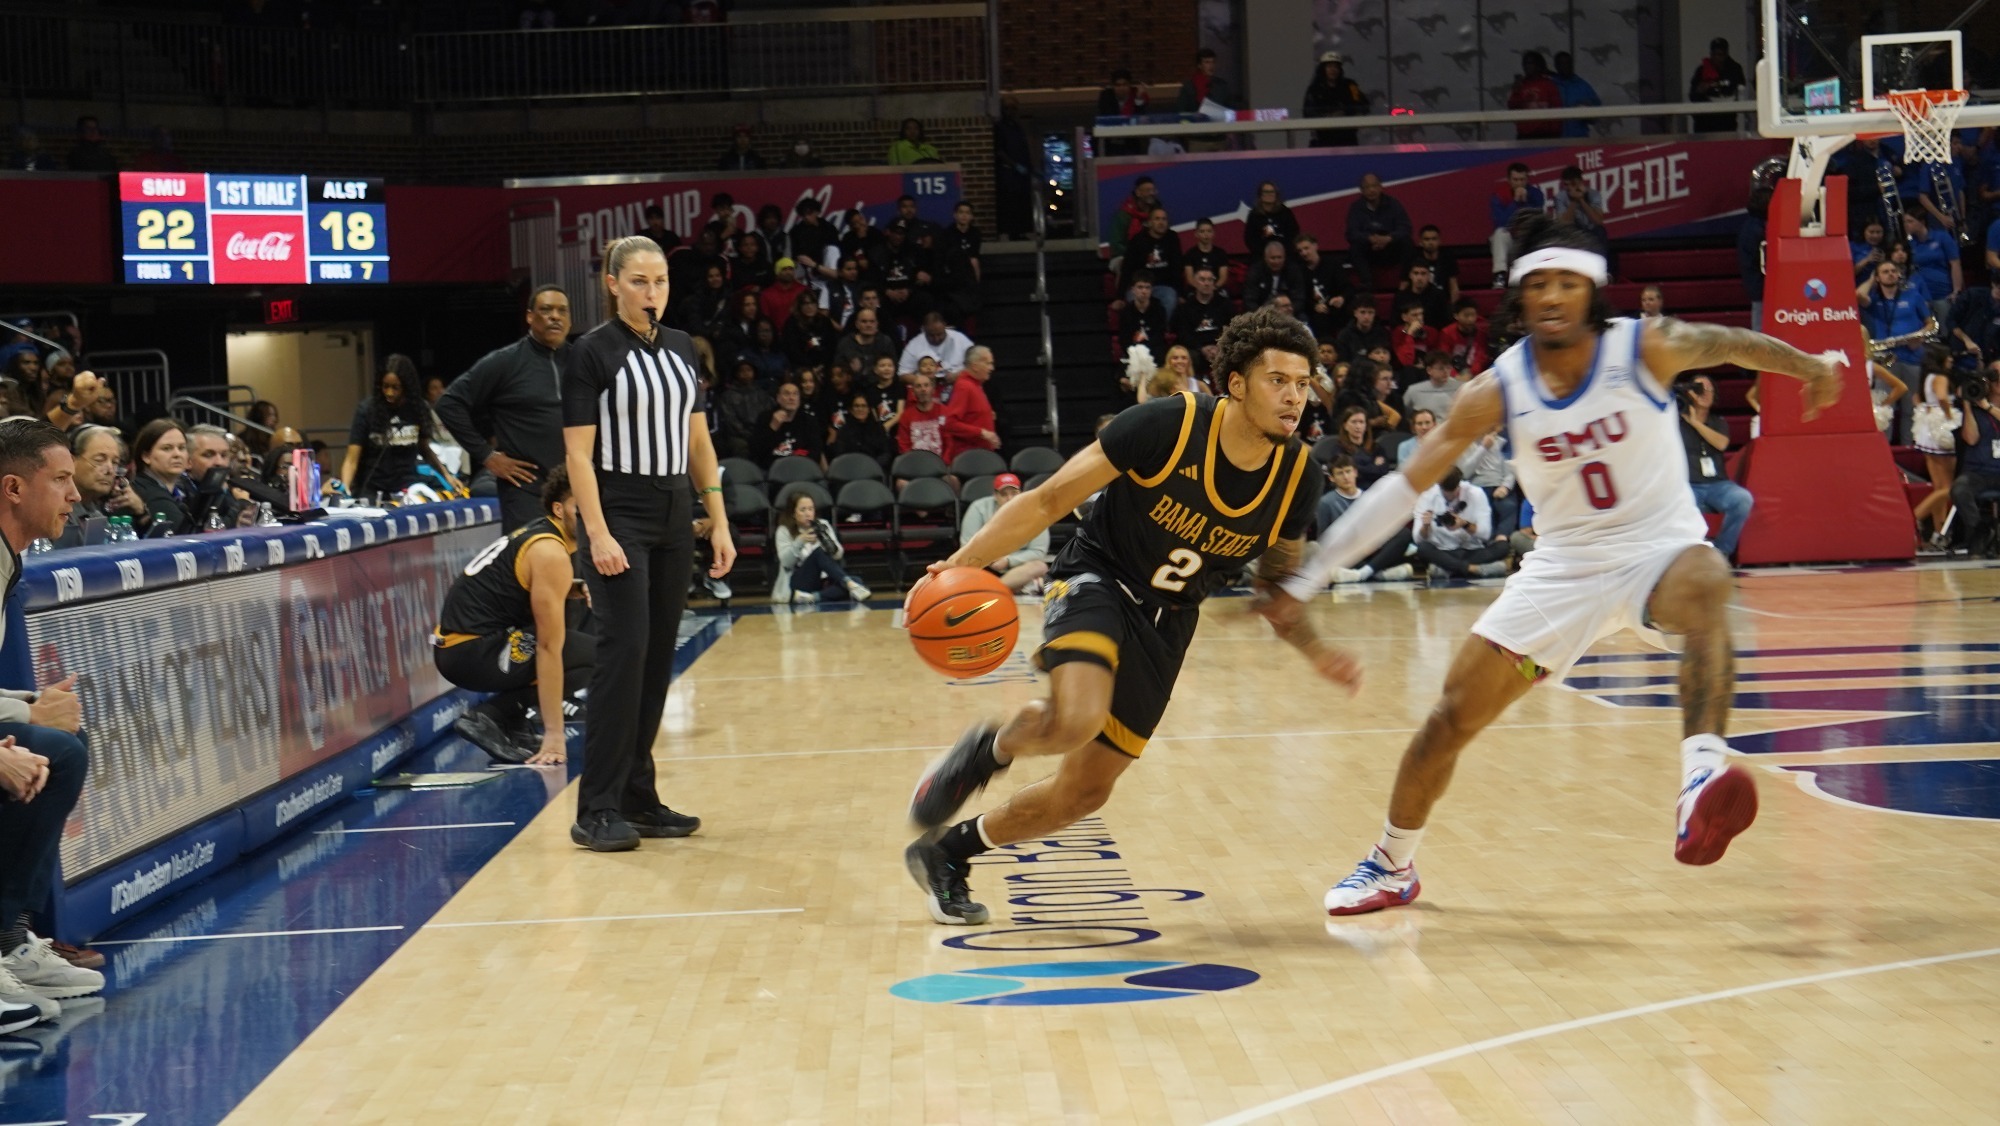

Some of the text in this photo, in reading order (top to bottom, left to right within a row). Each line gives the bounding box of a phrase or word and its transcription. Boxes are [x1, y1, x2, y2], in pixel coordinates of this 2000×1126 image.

[1576, 149, 1604, 170] THE
[141, 178, 186, 196] SMU
[216, 180, 297, 207] 1ST HALF
[323, 181, 368, 200] ALST
[913, 176, 946, 195] 115
[663, 188, 701, 238] UP
[136, 208, 196, 250] 22
[319, 210, 375, 251] 18
[136, 260, 194, 281] FOULS 1
[319, 261, 374, 281] FOULS 7
[270, 300, 293, 321] EXIT
[1774, 307, 1858, 326] Origin Bank
[1537, 410, 1628, 463] SMU
[1580, 460, 1619, 511] 0
[1149, 494, 1261, 558] BAMA STATE
[1151, 547, 1203, 593] 2
[948, 635, 1006, 661] ELITE
[941, 868, 1206, 951] Origin
